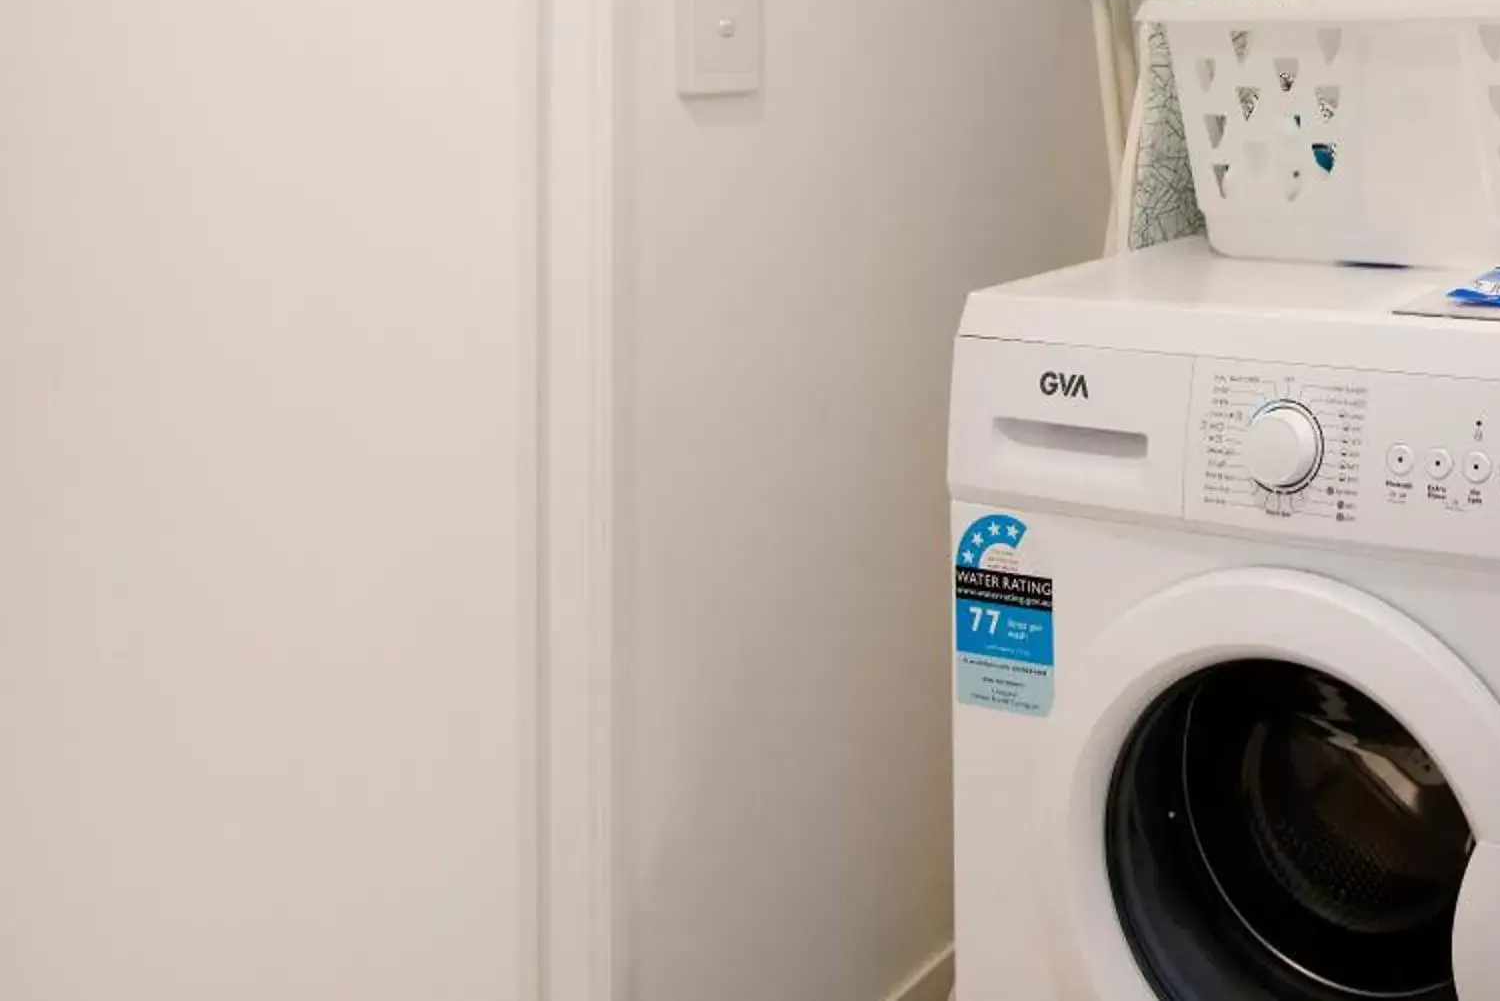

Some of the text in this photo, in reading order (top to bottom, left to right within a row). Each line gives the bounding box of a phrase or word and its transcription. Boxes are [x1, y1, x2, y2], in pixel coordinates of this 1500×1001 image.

[1039, 371, 1089, 399] GVA
[957, 570, 1052, 597] WATER RATING
[969, 605, 1001, 636] 77
